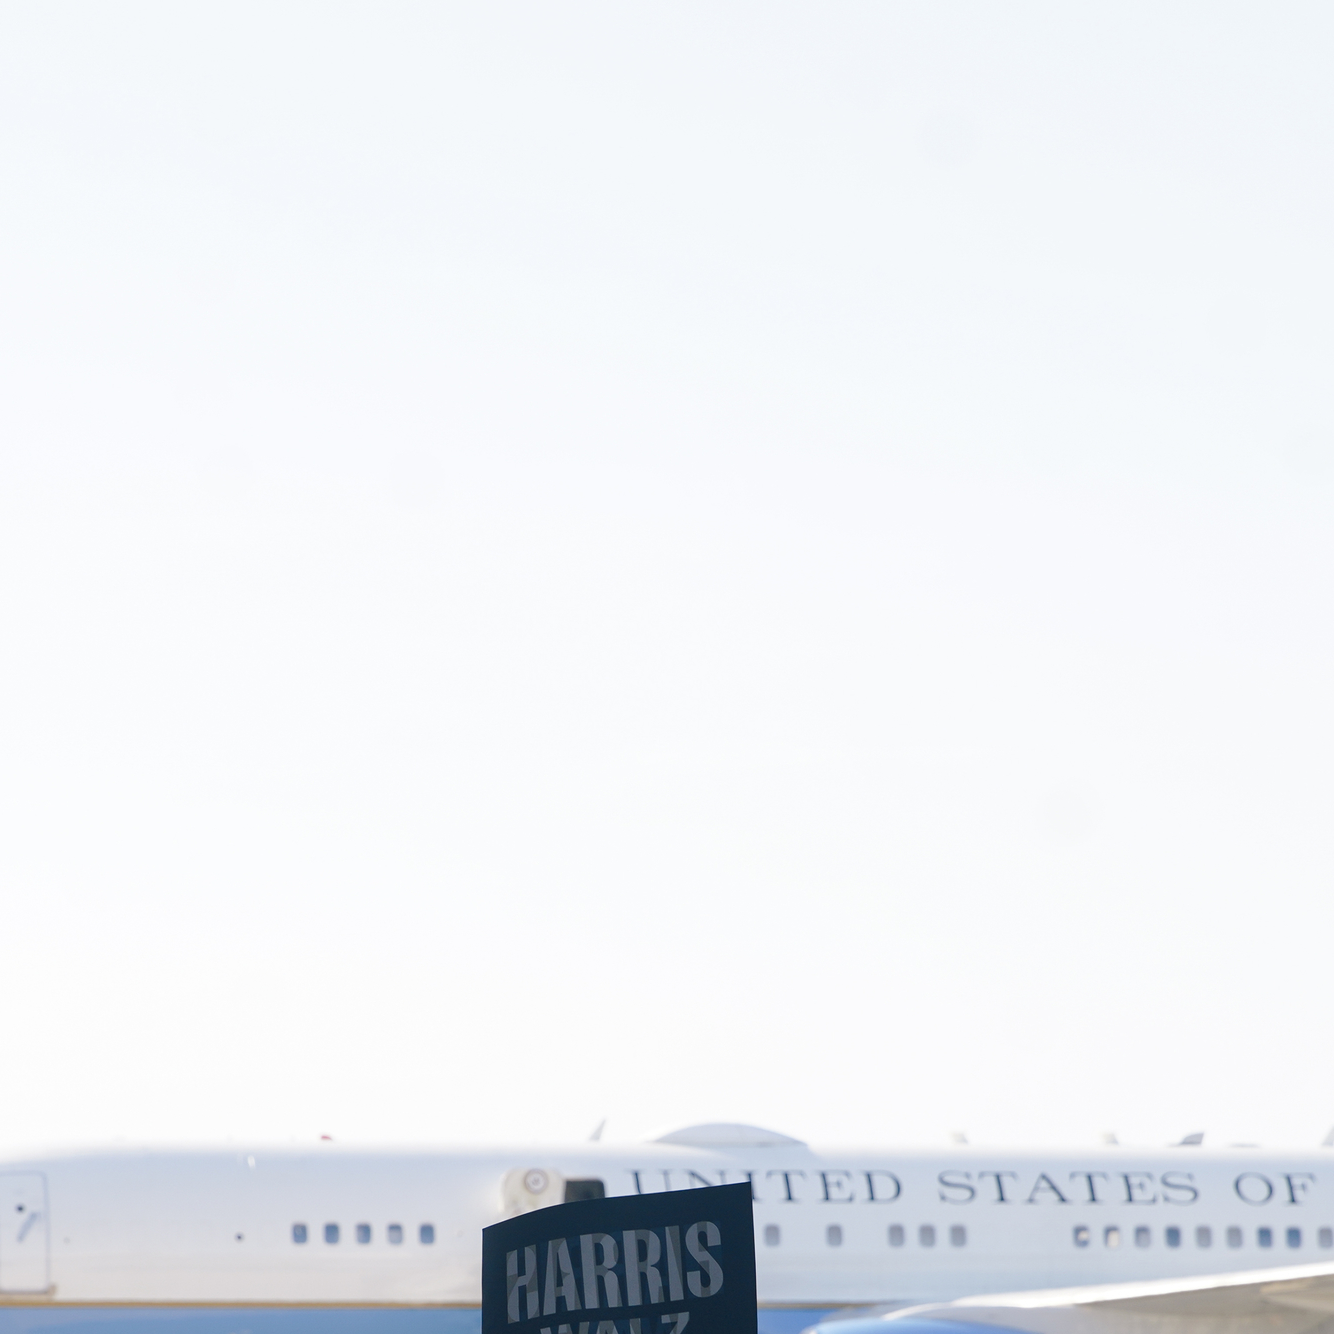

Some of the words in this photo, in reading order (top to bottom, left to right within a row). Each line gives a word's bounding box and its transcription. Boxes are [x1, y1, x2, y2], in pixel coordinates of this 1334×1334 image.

[624, 1169, 903, 1203] UNITED
[937, 1169, 1200, 1206] STATES
[1233, 1170, 1317, 1206] OF
[506, 1221, 724, 1324] HARRIS
